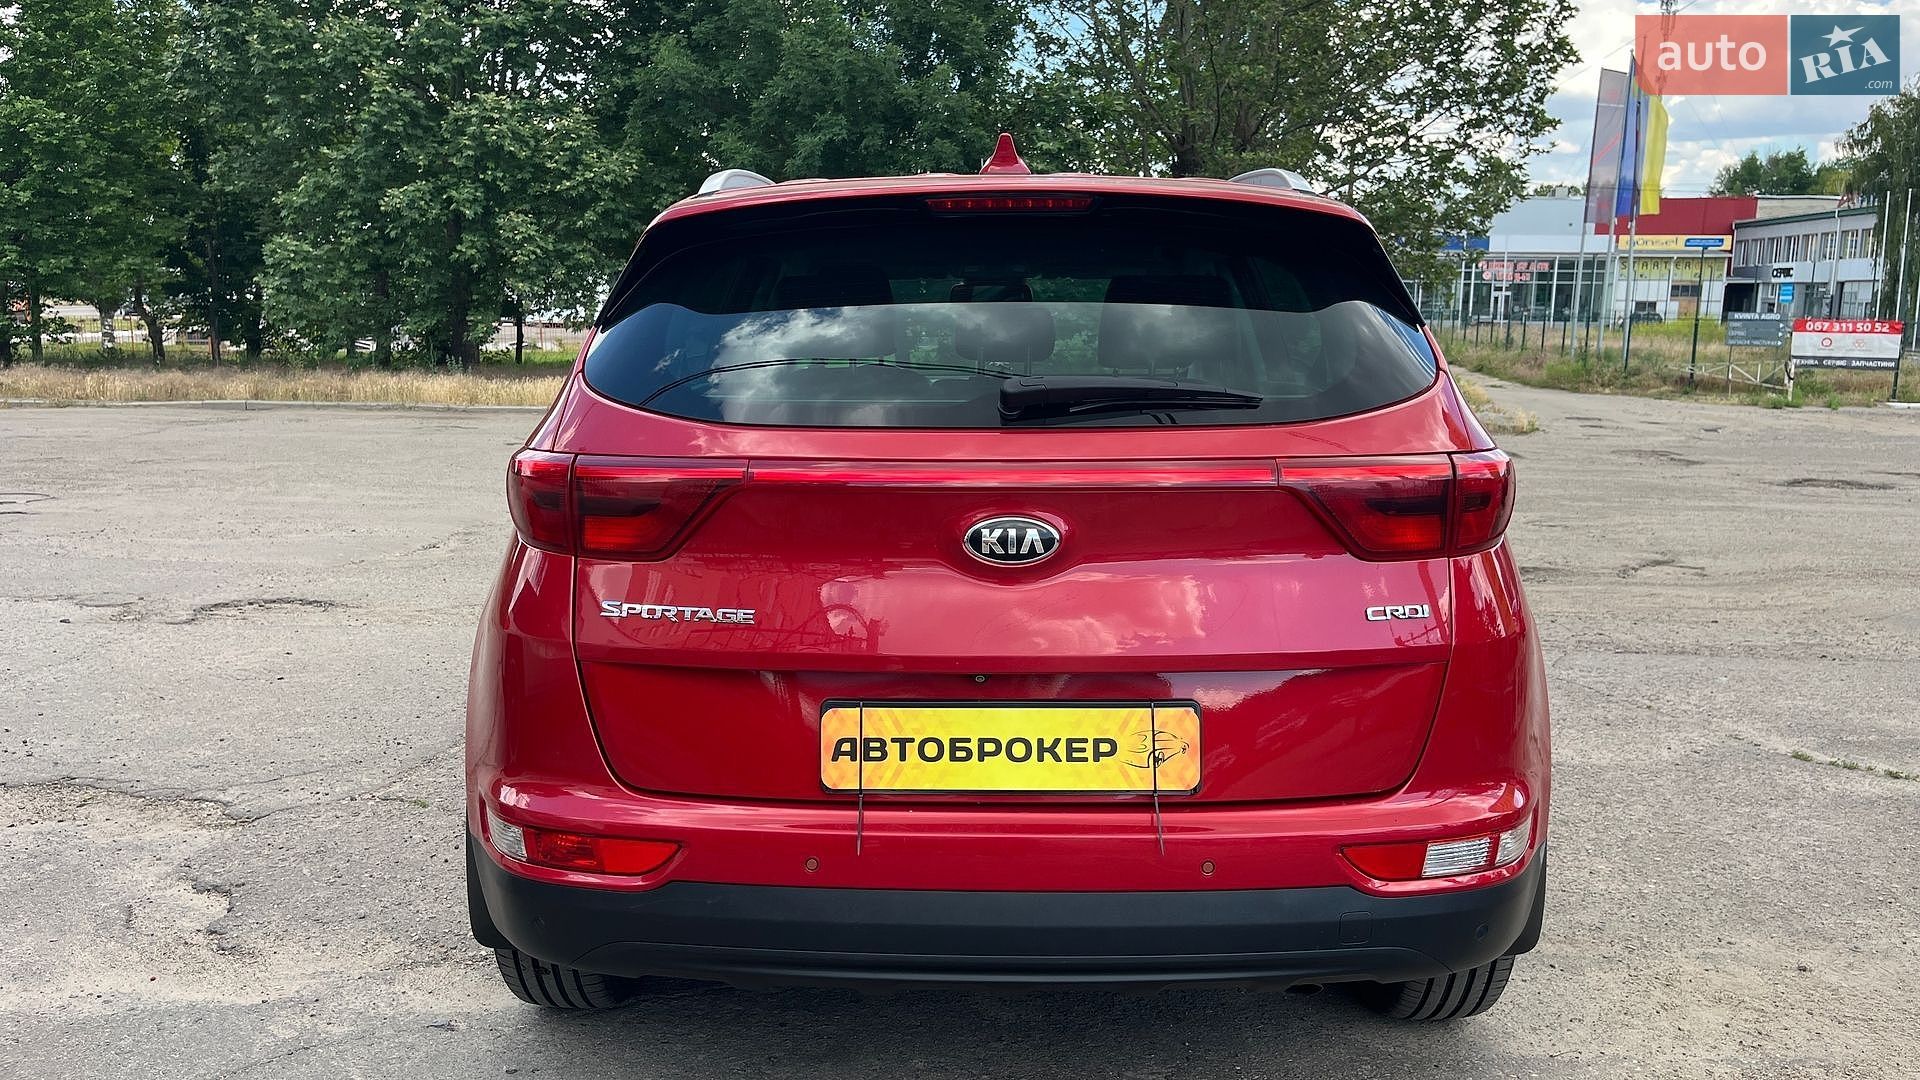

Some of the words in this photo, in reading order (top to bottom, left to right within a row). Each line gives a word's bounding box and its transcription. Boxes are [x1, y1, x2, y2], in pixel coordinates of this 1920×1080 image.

[1805, 321, 1829, 331] 067
[1832, 322, 1853, 332] 311
[1856, 322, 1871, 332] 50
[1874, 322, 1890, 333] 52
[980, 528, 1045, 554] KIA
[600, 600, 756, 624] SPORTAGE
[1366, 604, 1430, 621] CRDI
[831, 737, 1118, 762] АВТОБРОКЕР
